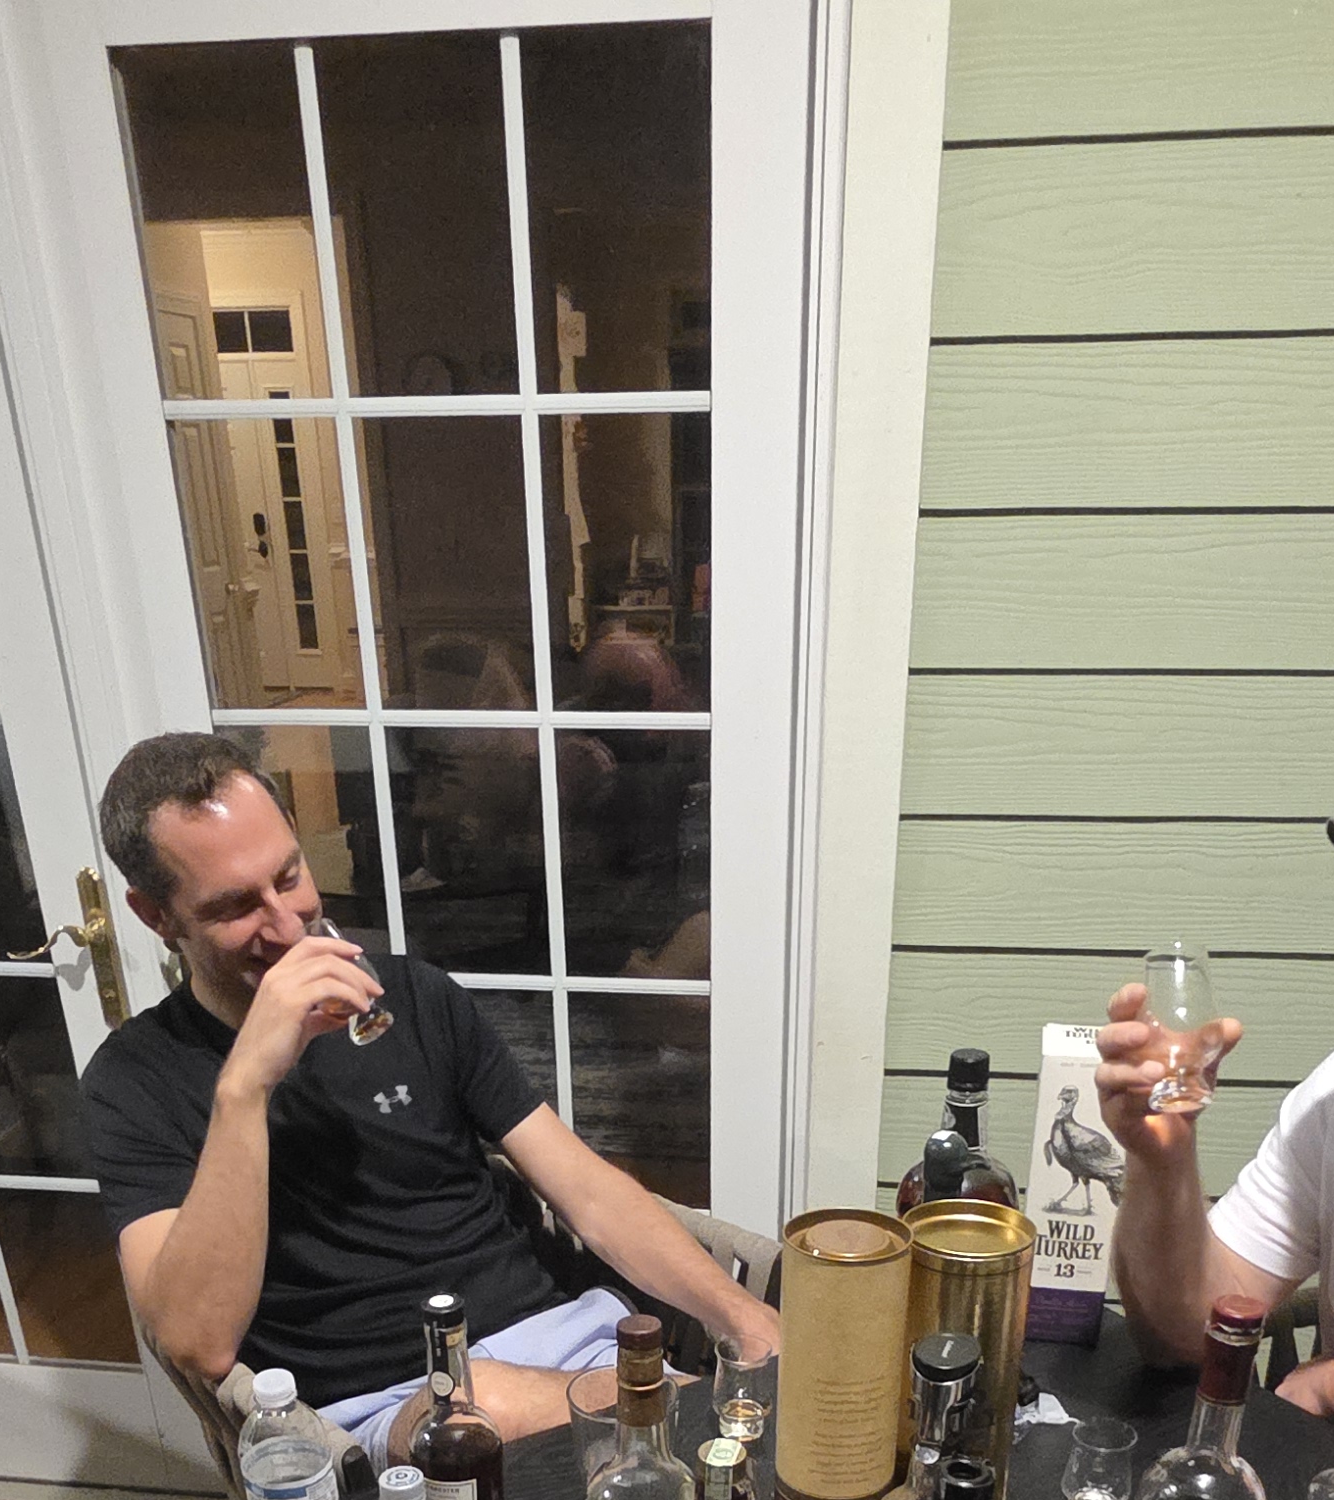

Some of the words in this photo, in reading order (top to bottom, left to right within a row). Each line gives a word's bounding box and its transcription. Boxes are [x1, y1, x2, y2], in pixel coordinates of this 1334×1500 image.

[1047, 1219, 1095, 1242] WILD
[1035, 1234, 1104, 1261] TURKEY
[1054, 1262, 1076, 1279] 13
